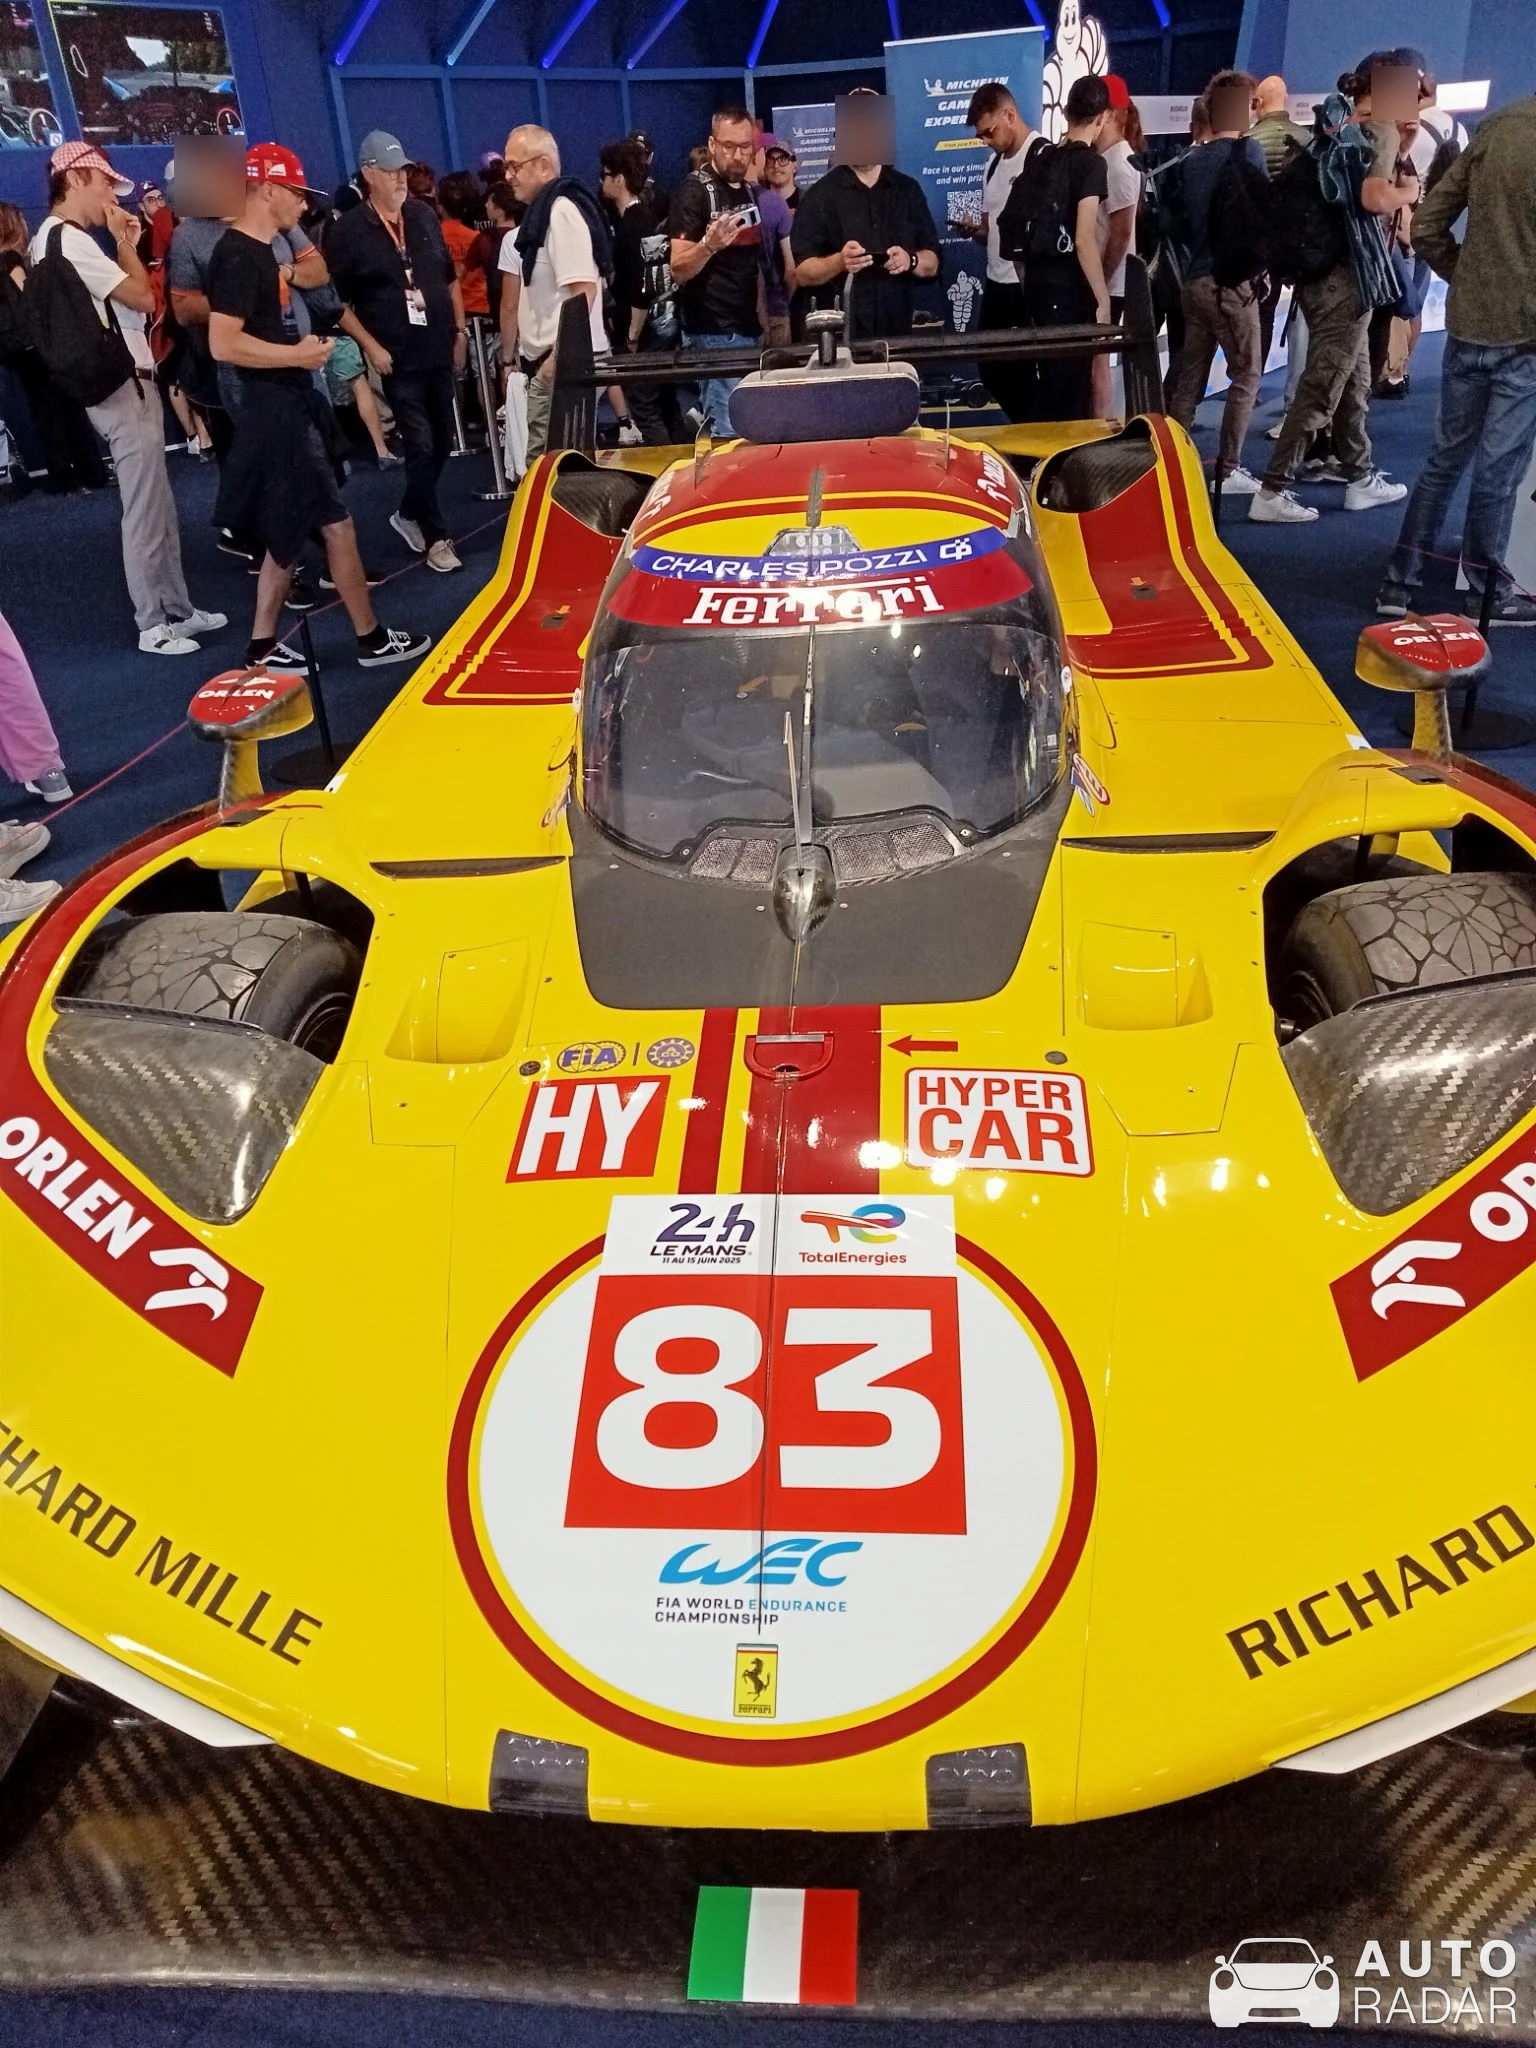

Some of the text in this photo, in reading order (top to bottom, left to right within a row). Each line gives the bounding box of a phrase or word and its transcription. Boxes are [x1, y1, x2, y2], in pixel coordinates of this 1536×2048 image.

[946, 76, 1009, 90] MICHELIN
[937, 99, 971, 111] GAM
[924, 114, 968, 128] EXPER
[923, 167, 941, 175] Race
[942, 165, 950, 173] in
[966, 163, 985, 172] simu
[936, 173, 984, 185] and win priz
[652, 555, 808, 577] CHARLES
[819, 550, 927, 575] POZZI
[682, 576, 945, 625] Ferrari
[198, 689, 275, 700] ORLEN
[918, 1076, 1073, 1111] HYPER
[515, 1081, 661, 1175] HY
[918, 1107, 1079, 1165] CAR
[0, 1116, 154, 1260] ORLEN
[650, 1245, 747, 1256] LE MANS
[697, 1257, 718, 1265] JUIN
[799, 1252, 907, 1266] TotalEnergies
[596, 1304, 942, 1490] 83
[0, 1421, 323, 1666] HARD MILLE
[659, 1538, 864, 1587] WEC
[1226, 1504, 1536, 1680] RICHARD
[656, 1597, 847, 1612] FIA WORLD ENDURANCE
[655, 1611, 779, 1625] CHAMPIONSHIP
[738, 1704, 772, 1714] Ferrari
